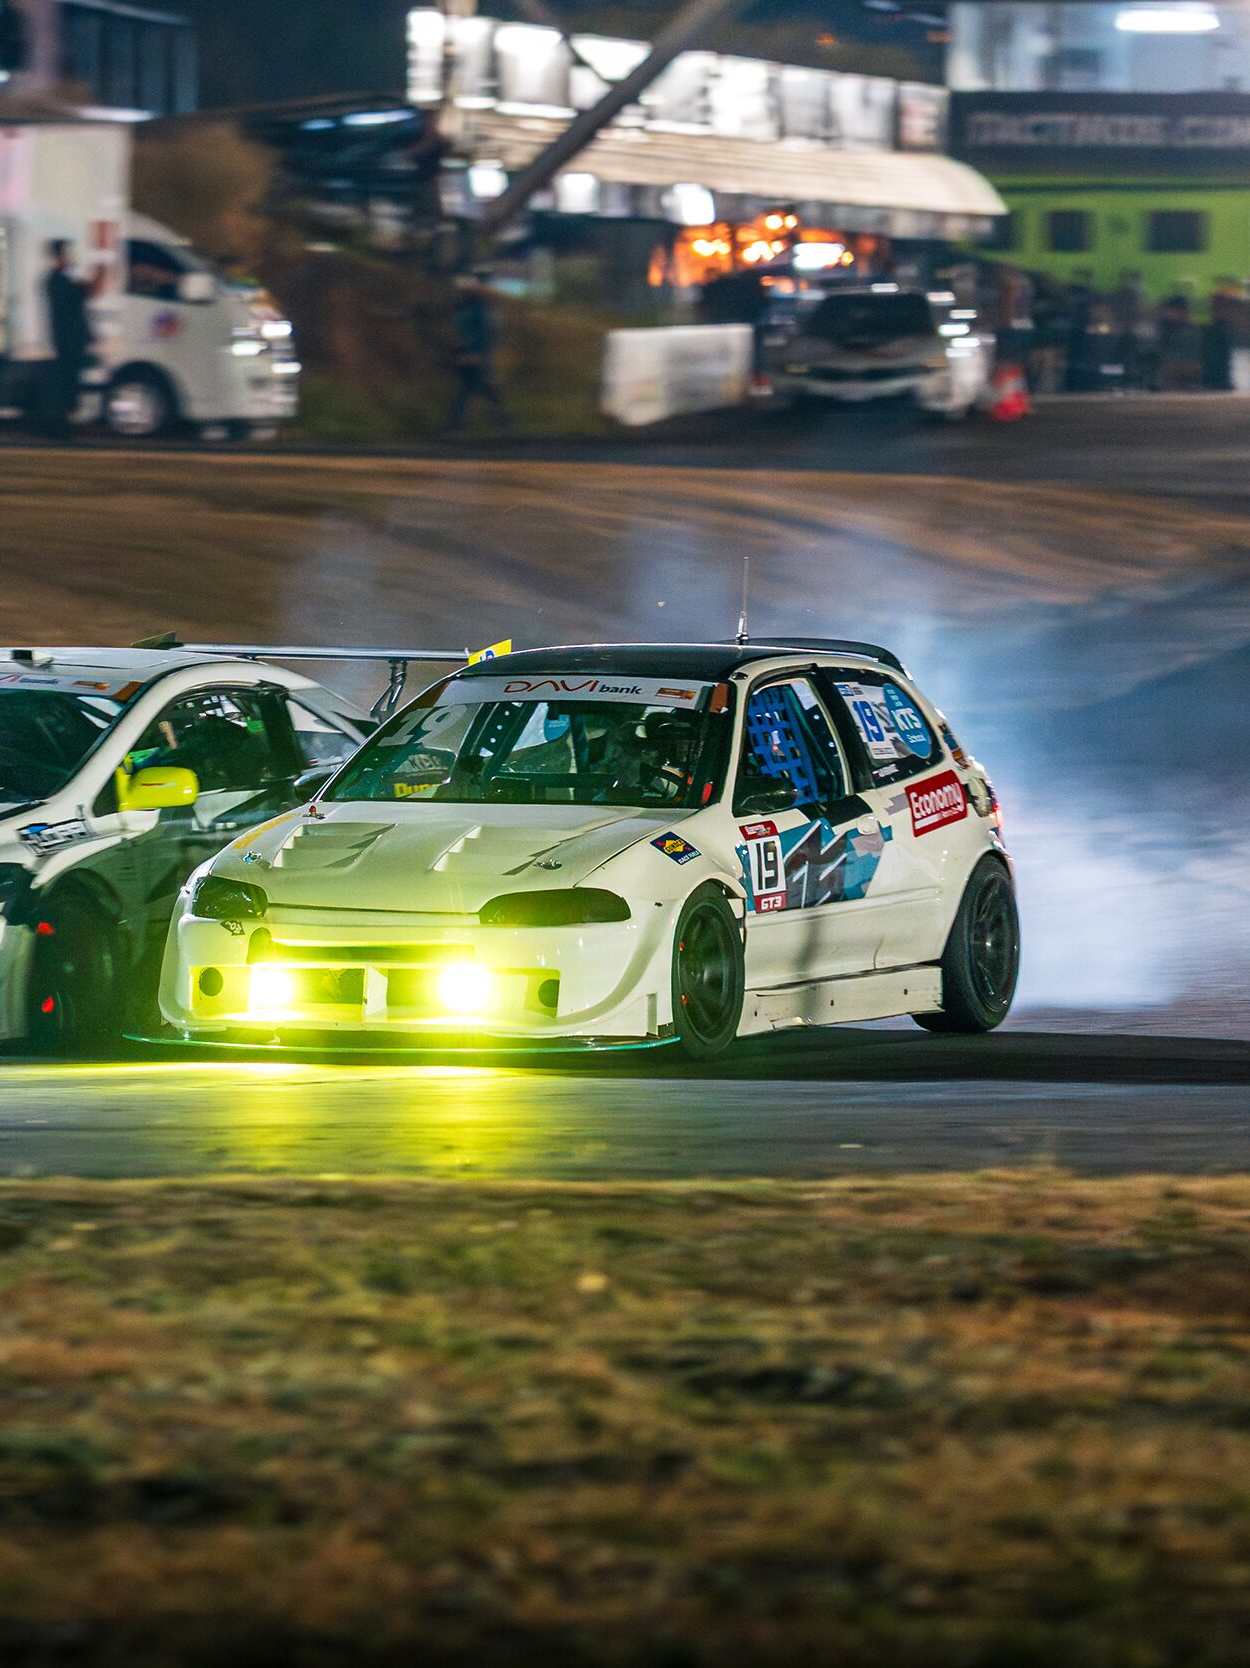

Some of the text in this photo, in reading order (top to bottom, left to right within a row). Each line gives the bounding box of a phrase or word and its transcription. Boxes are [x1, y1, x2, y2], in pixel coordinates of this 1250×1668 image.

[504, 680, 642, 695] DAVI bank
[376, 704, 468, 747] 19
[852, 700, 885, 742] 19
[891, 707, 922, 731] KTS
[910, 782, 965, 819] Economy
[755, 840, 780, 891] 19
[761, 896, 782, 910] GT3
